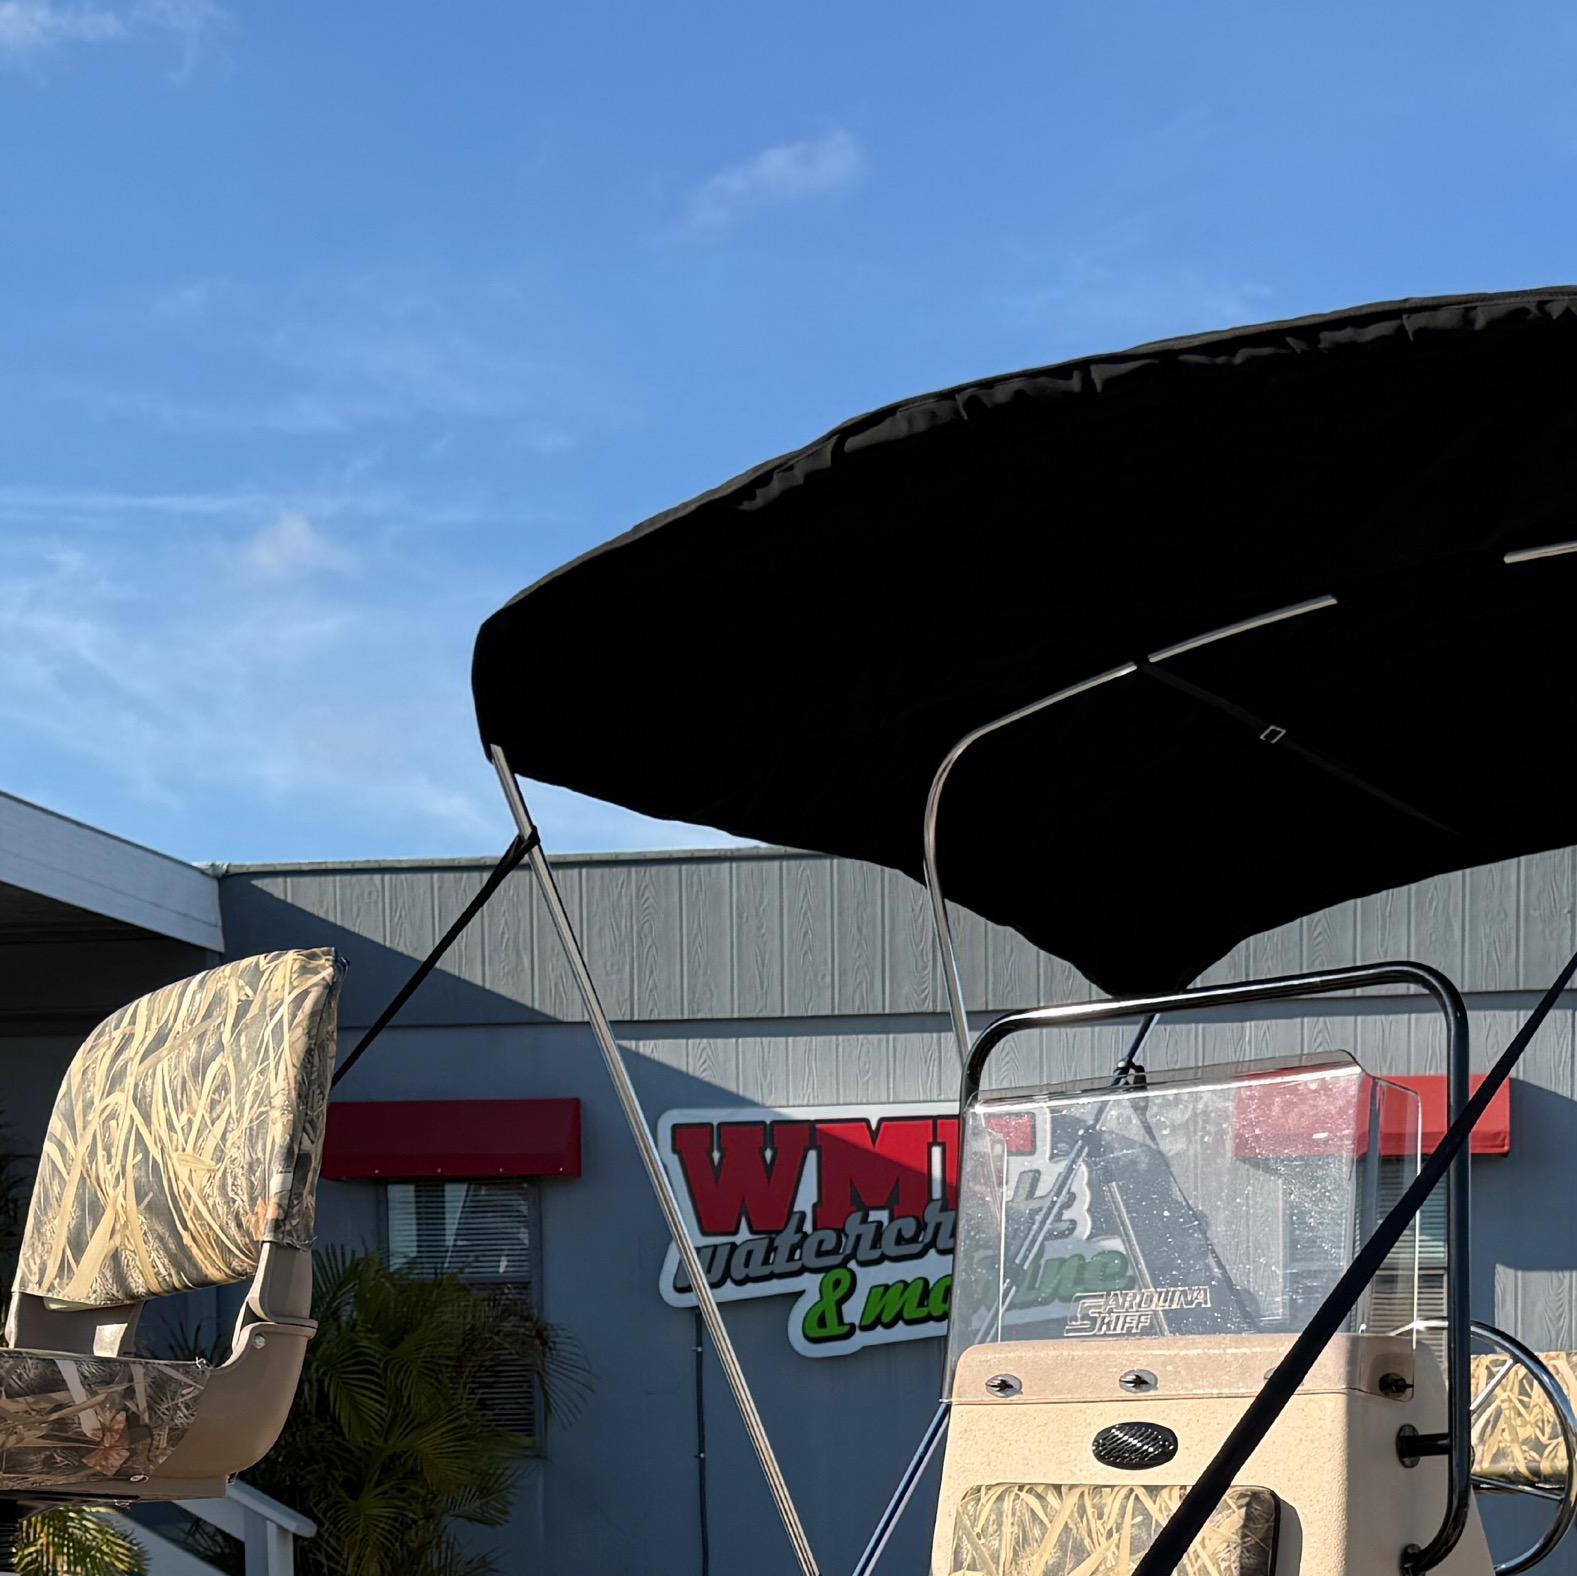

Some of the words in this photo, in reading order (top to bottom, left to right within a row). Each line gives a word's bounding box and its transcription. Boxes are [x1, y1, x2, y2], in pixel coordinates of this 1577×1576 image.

[803, 1267, 856, 1342] &
[1064, 1298, 1152, 1336] SKIFF
[1067, 1286, 1212, 1325] CAROLINA
